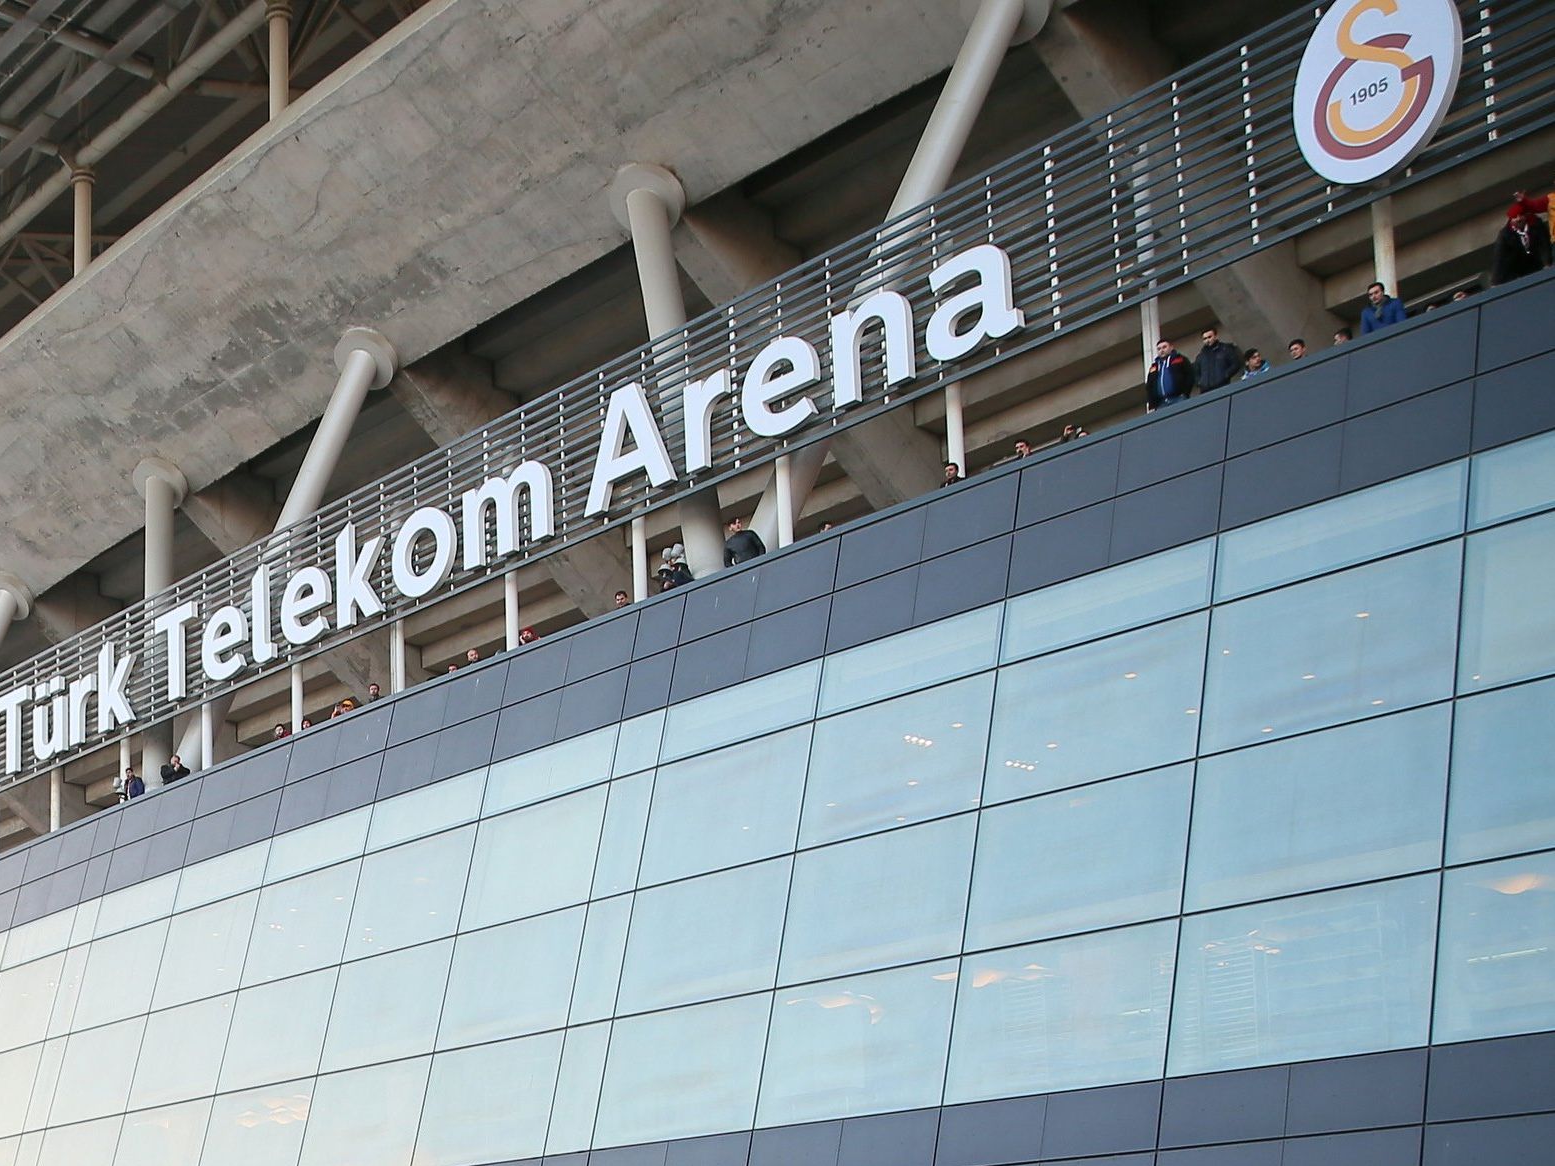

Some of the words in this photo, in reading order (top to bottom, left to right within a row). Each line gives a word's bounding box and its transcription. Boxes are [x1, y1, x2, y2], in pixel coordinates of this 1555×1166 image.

[1350, 77, 1388, 106] 1905
[154, 458, 555, 700] Telekom
[583, 244, 1026, 519] Arena
